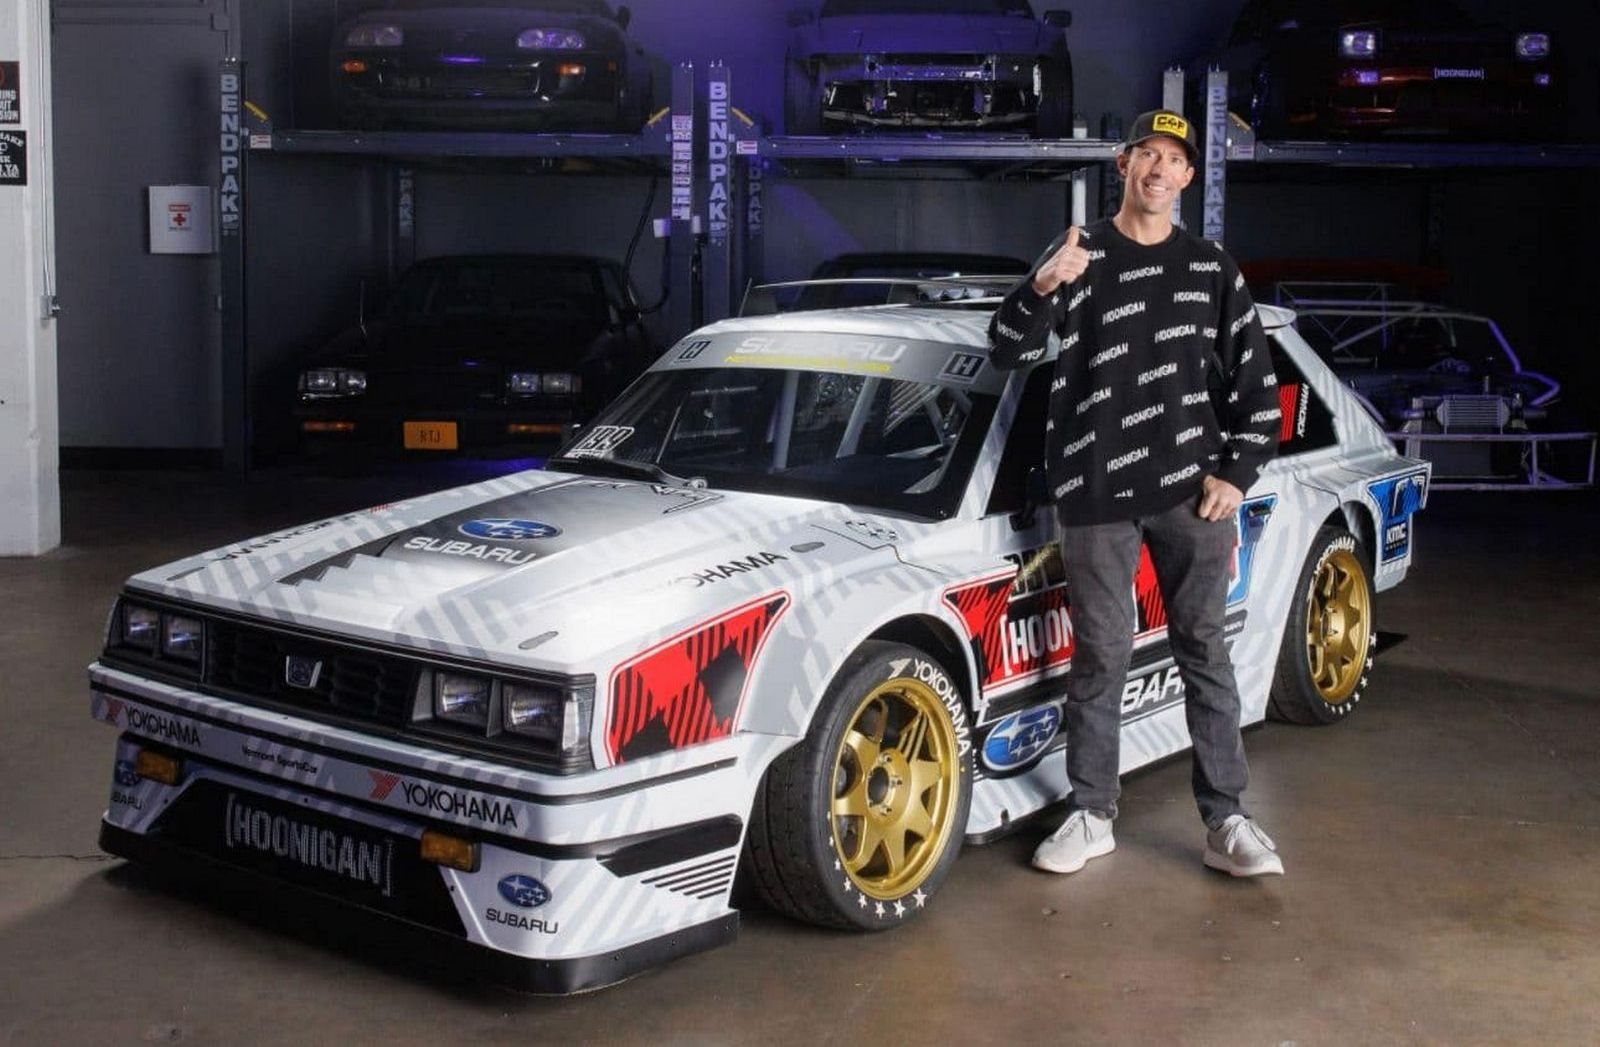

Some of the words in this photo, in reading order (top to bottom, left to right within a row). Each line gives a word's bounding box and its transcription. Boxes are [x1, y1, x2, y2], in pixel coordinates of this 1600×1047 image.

[1119, 264, 1164, 283] HOONIGAN
[1102, 301, 1146, 326] HOONIGAN
[1154, 324, 1197, 343] HOONIGAN
[1138, 362, 1177, 386] HOONIGAN
[1122, 403, 1164, 429] HOONIGAN
[1107, 446, 1149, 474] HOONIGAN
[404, 535, 537, 566] SUBARU
[914, 658, 972, 757] YOKOHAMA
[124, 705, 201, 747] YOKOHAMA
[401, 781, 517, 828] YOKOHAMA
[226, 793, 394, 897] [HOONIGAN]
[485, 908, 559, 934] SUBARU
